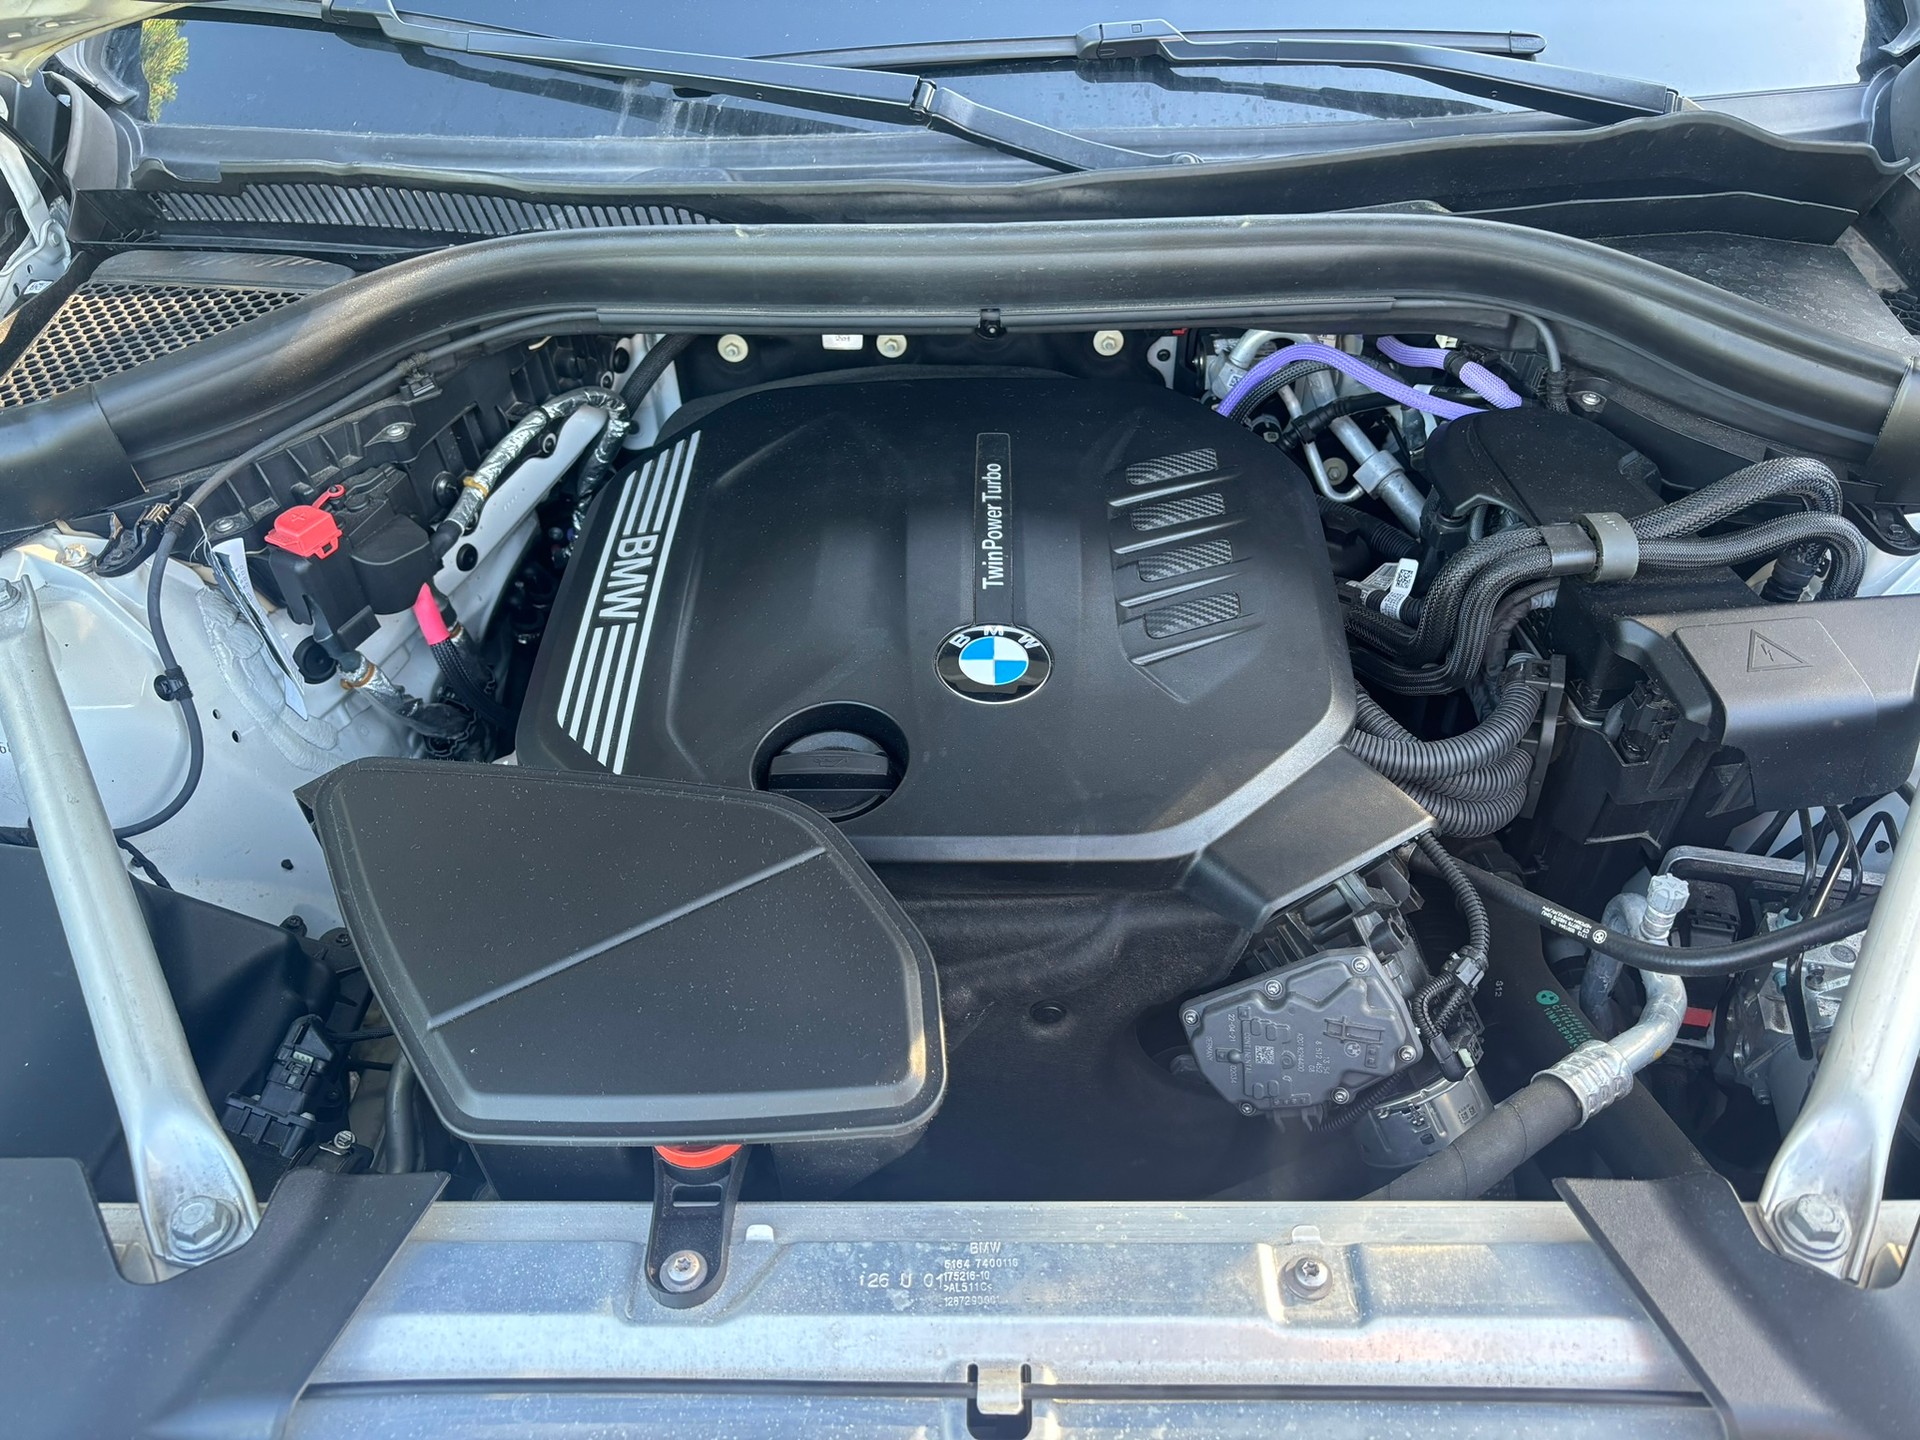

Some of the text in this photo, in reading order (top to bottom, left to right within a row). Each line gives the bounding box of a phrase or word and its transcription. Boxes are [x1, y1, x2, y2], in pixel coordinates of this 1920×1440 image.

[981, 463, 1003, 503] Turbo
[599, 534, 660, 619] BMW
[949, 624, 1041, 651] BMW
[1228, 1013, 1236, 1043] 22-04-21
[1315, 1047, 1323, 1060] 512
[970, 1241, 1001, 1254] BMW
